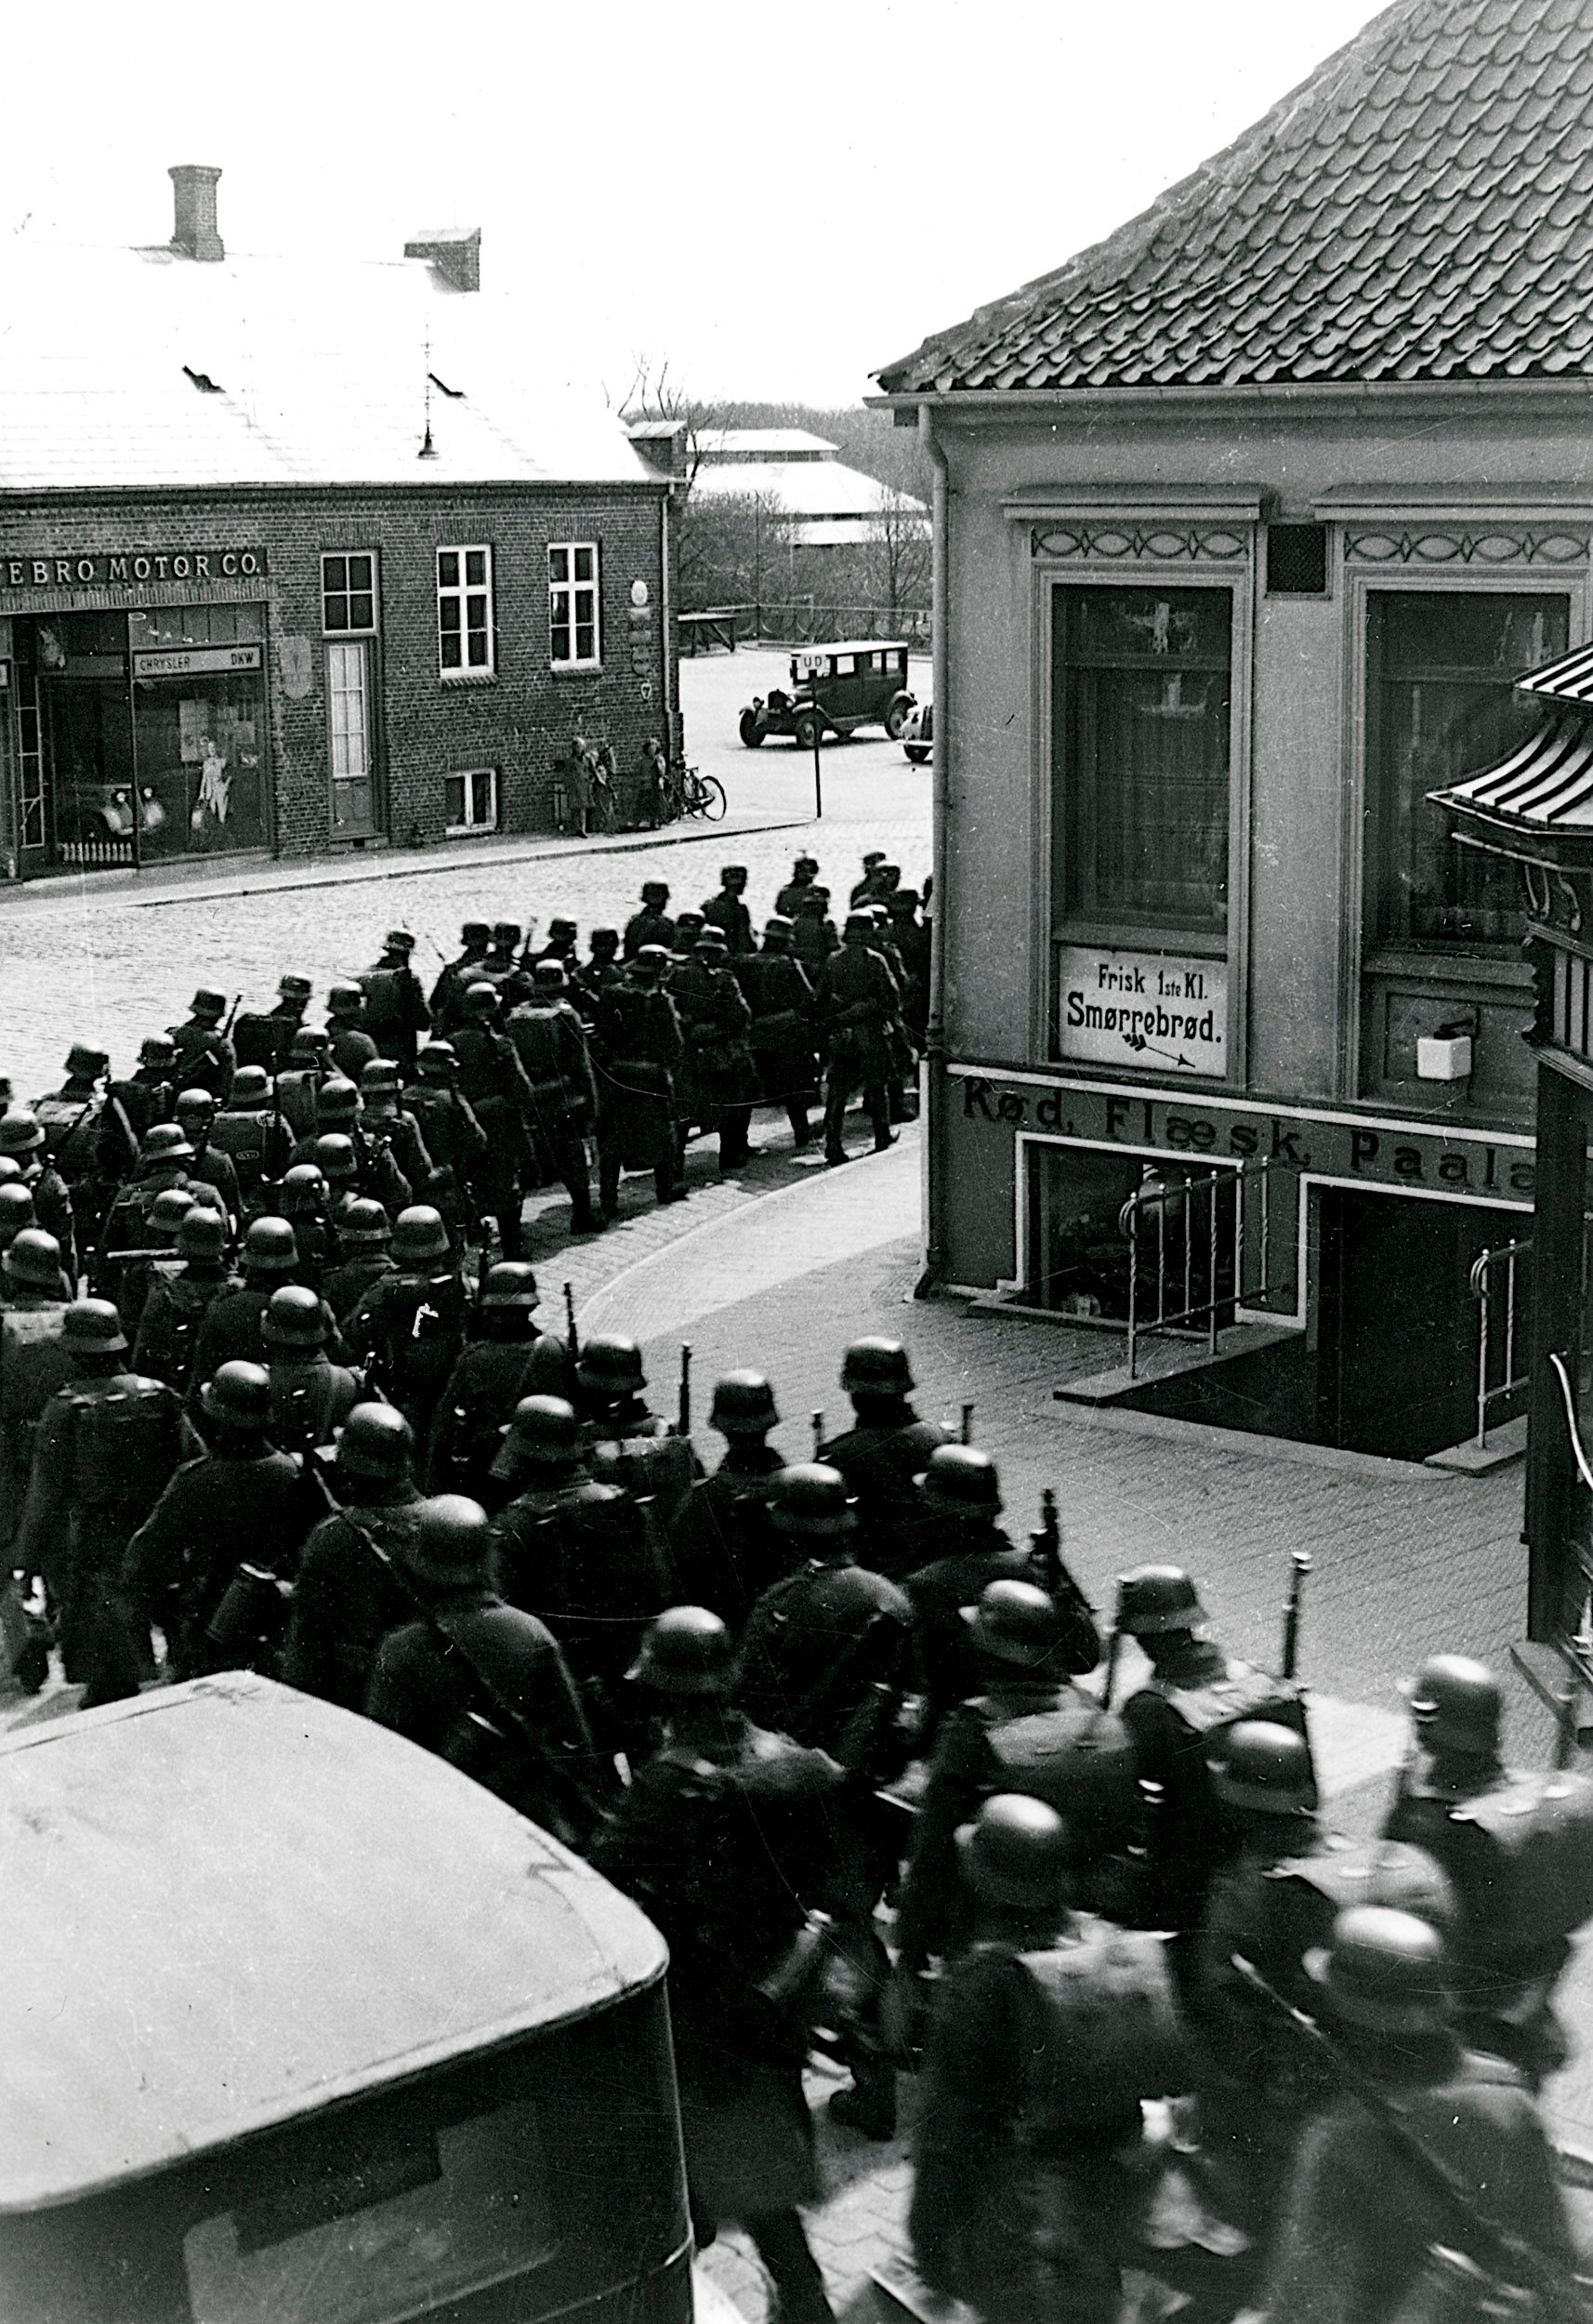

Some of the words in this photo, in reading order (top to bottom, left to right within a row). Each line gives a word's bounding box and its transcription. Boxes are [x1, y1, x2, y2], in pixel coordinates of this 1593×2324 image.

[0, 560, 94, 584] EBRO
[109, 556, 209, 580] MOTOR
[222, 553, 261, 575] CO.
[140, 656, 191, 671] CHRYSLER
[231, 653, 254, 666] DKW
[1099, 964, 1145, 993] Frisk
[1068, 991, 1222, 1043] Smørrebrød.
